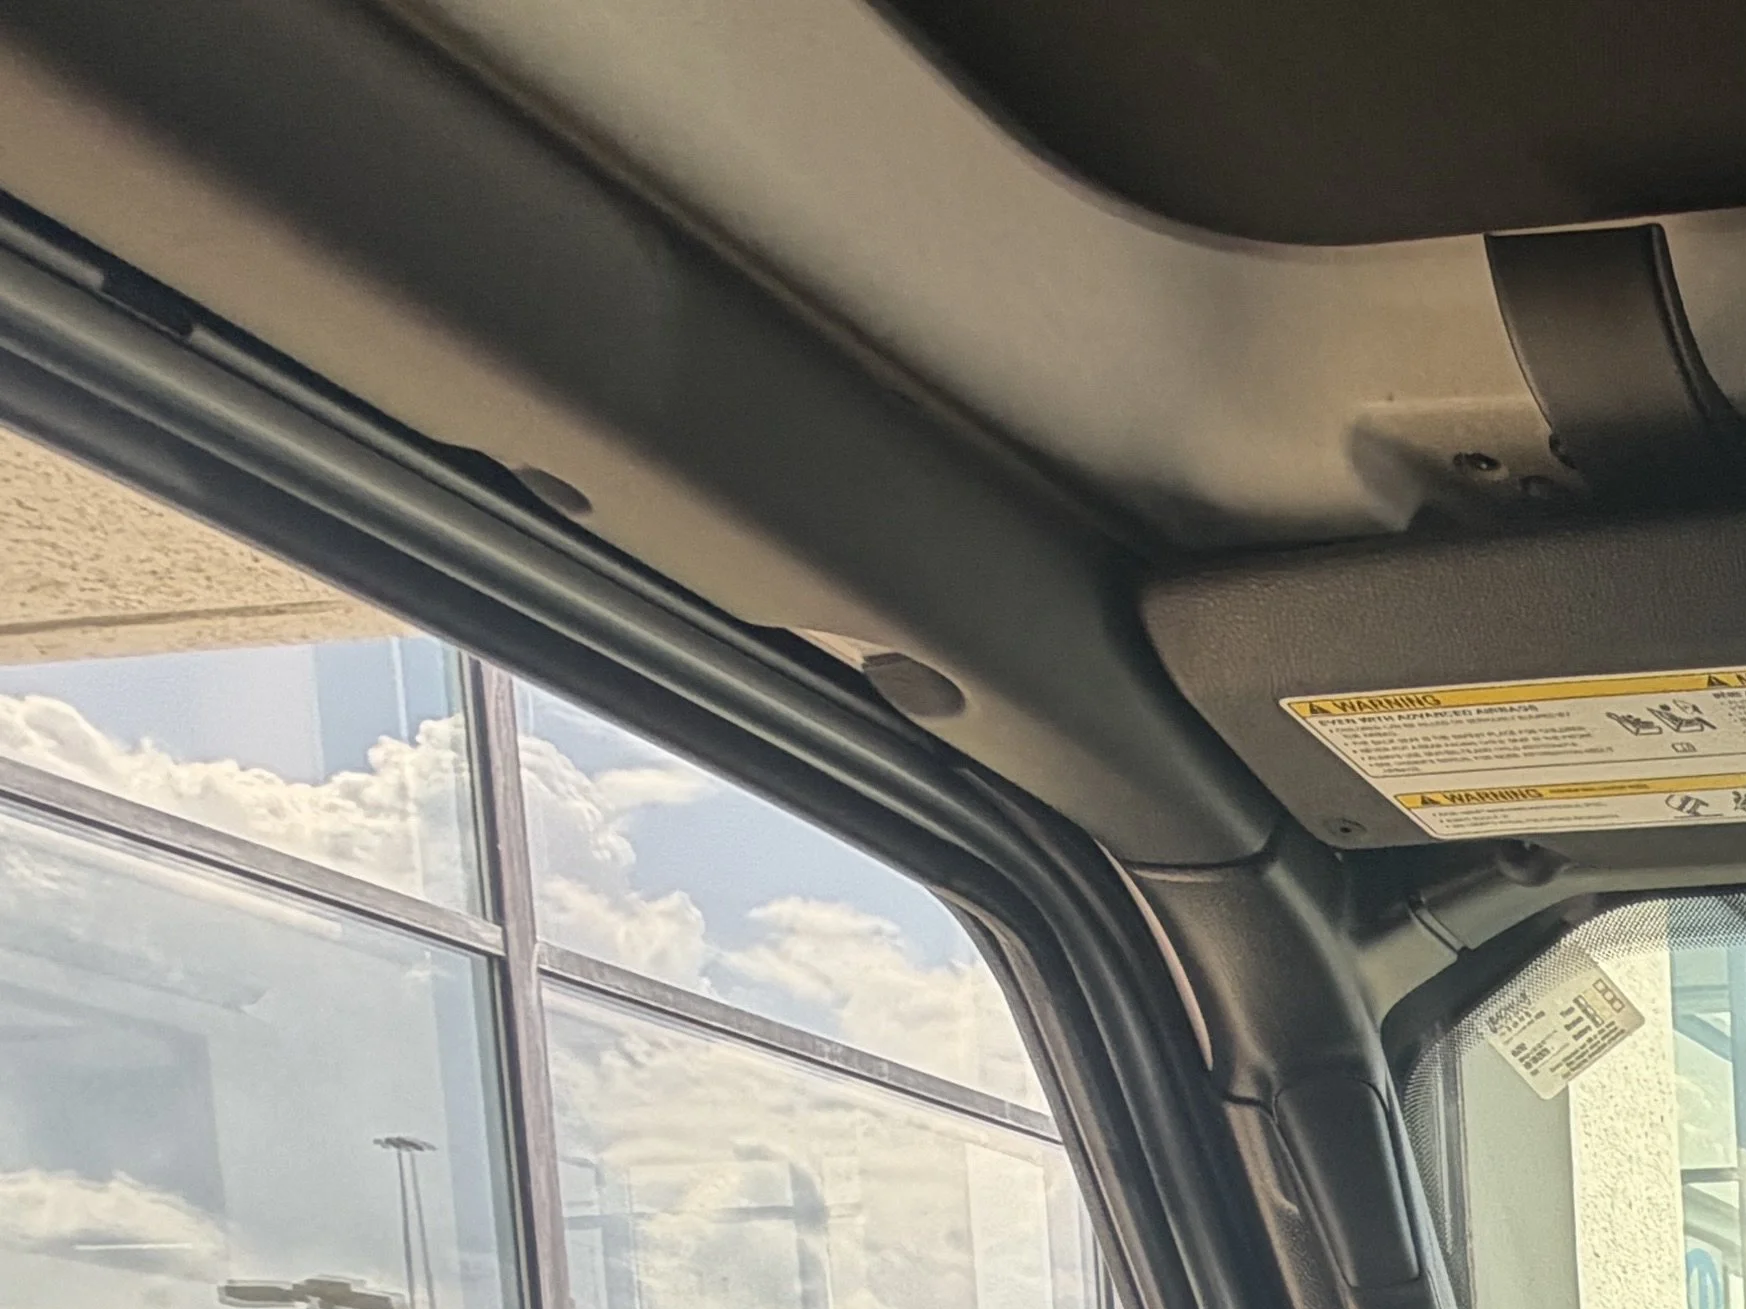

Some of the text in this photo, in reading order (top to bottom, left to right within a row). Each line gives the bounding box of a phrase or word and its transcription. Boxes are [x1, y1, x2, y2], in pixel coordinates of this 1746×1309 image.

[1333, 694, 1441, 714] WARNING
[1318, 716, 1354, 727] EVEN
[1358, 713, 1394, 724] WITH
[1397, 708, 1473, 721] ADVANCED
[1443, 788, 1544, 805] WARNING
